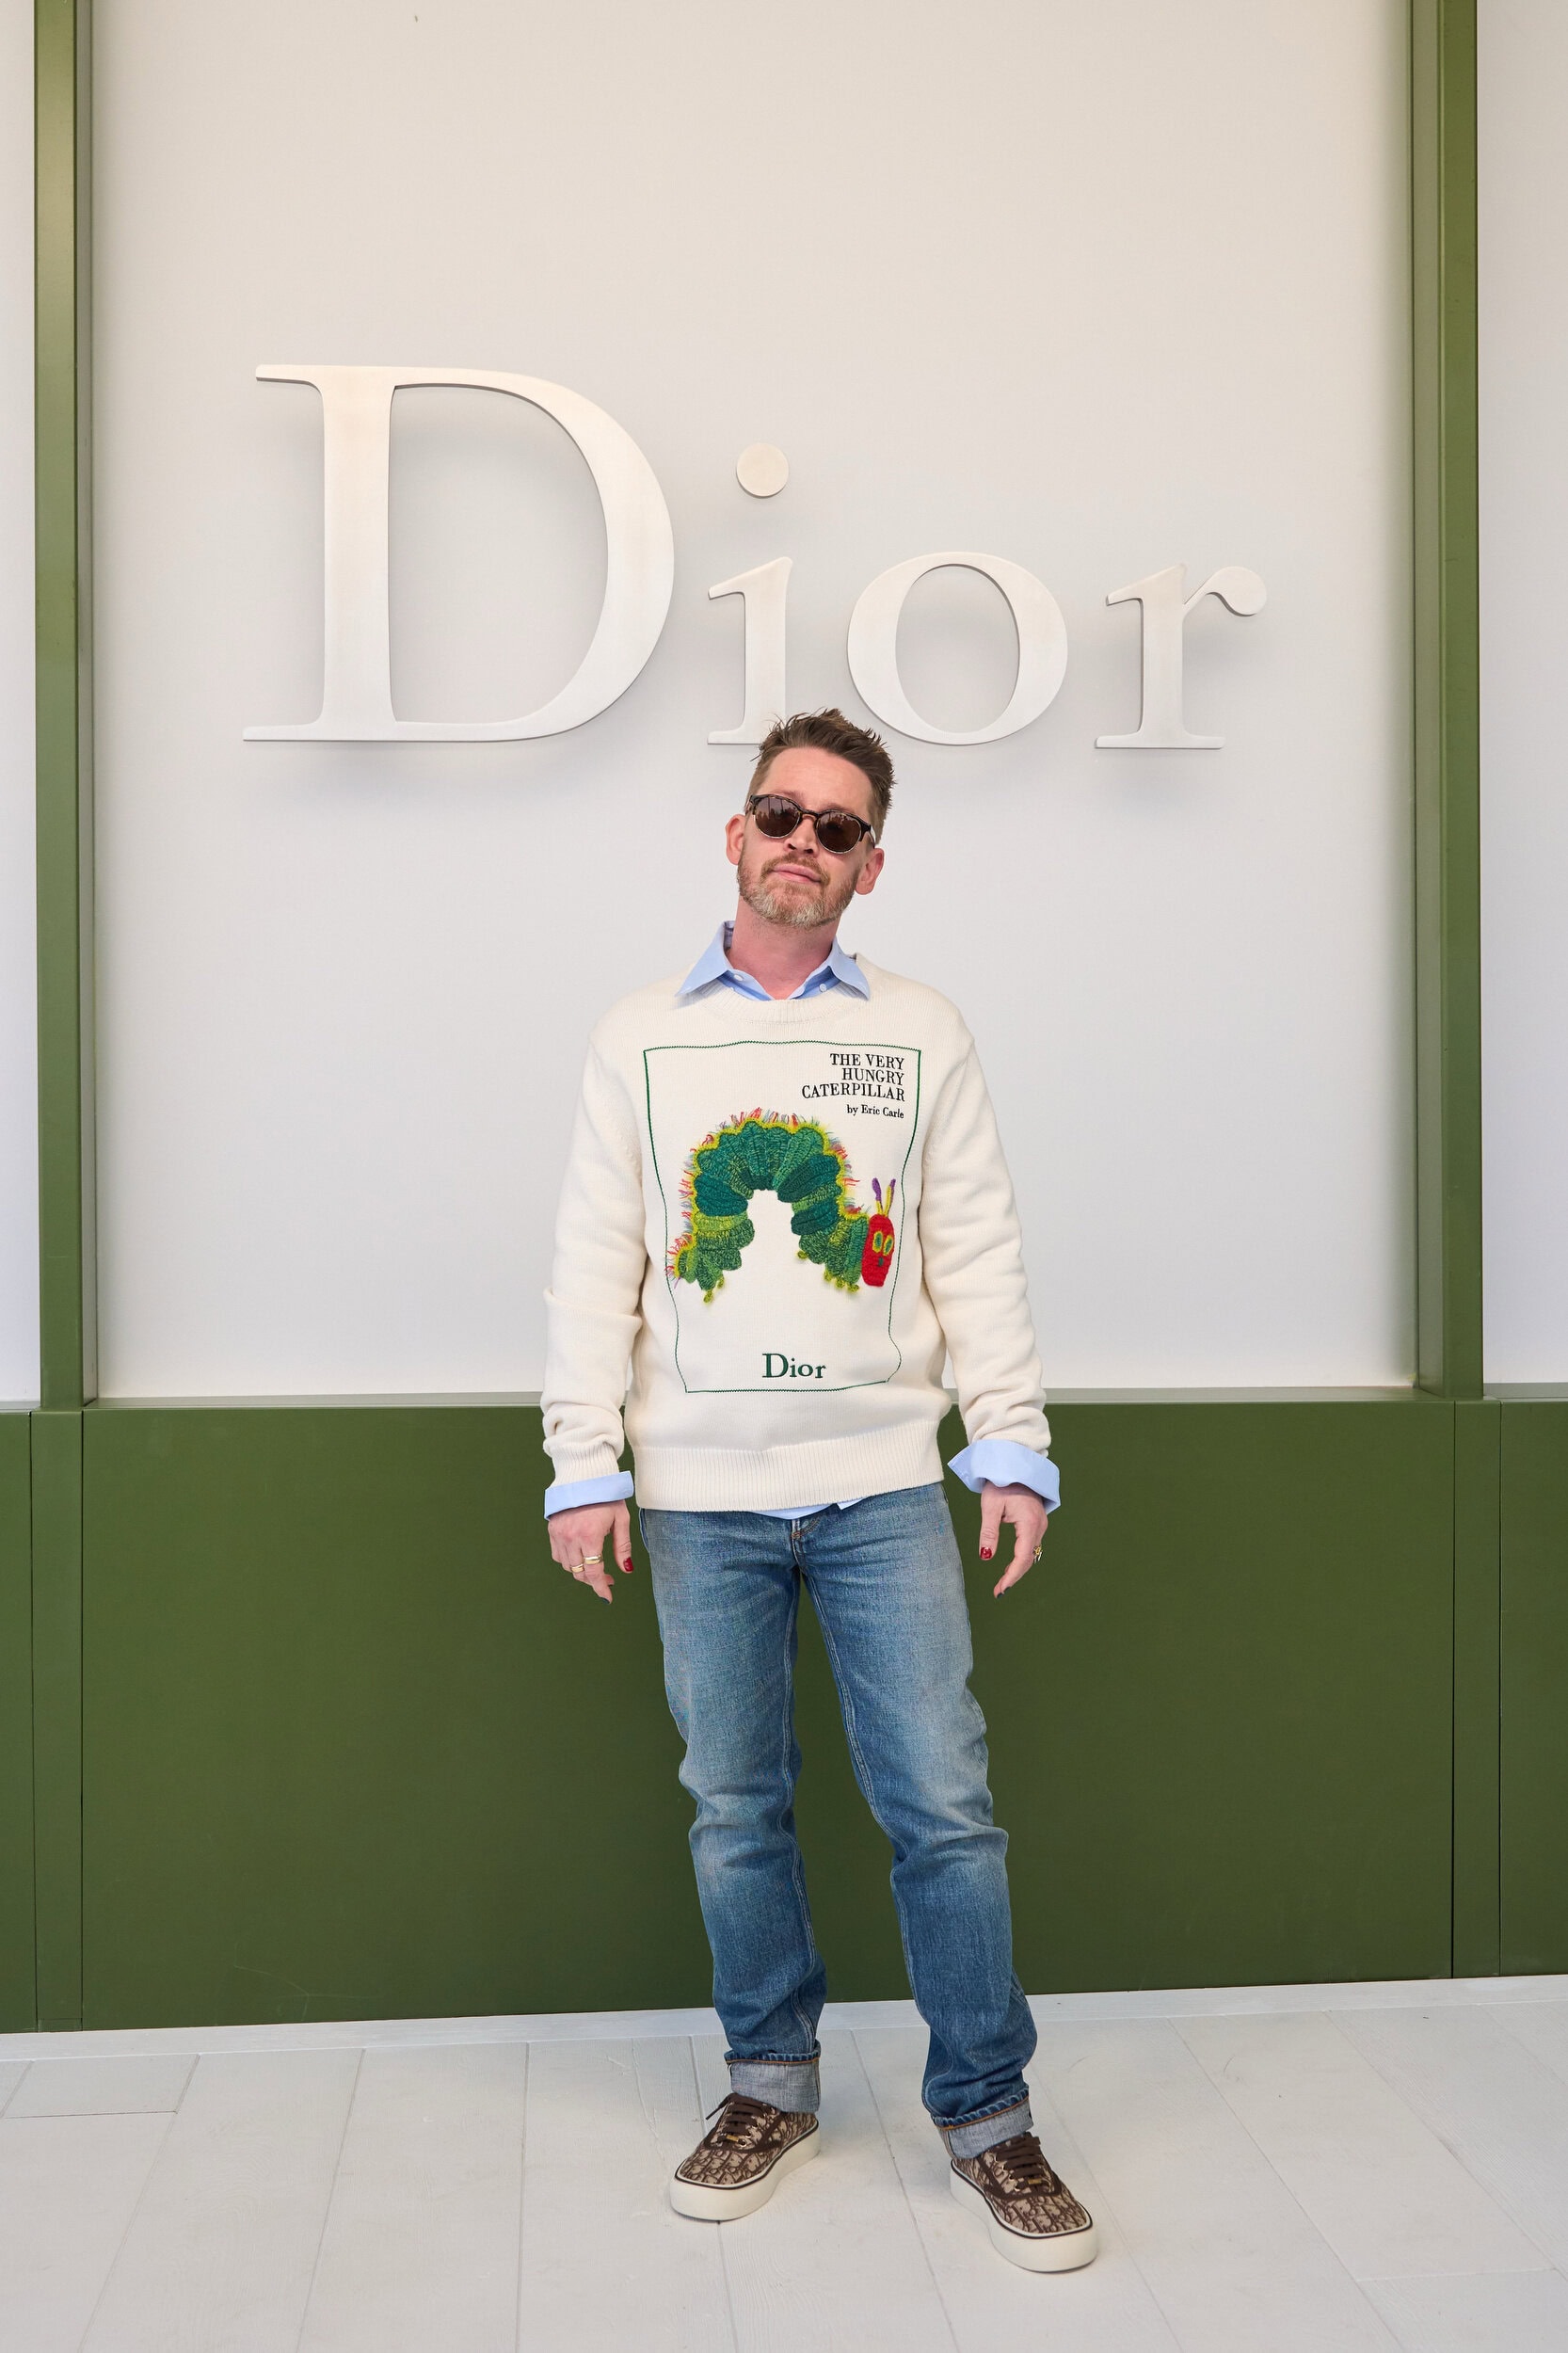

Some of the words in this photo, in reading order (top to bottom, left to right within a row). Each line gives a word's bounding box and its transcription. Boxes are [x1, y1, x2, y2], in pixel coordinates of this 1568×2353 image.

[242, 363, 1268, 749] Dior
[830, 1053, 861, 1066] THE
[865, 1053, 904, 1070] VERY
[841, 1067, 904, 1086] HUNGRY
[801, 1082, 905, 1102] CATERPILLAR
[847, 1104, 858, 1116] by
[861, 1104, 880, 1115] Eric
[882, 1107, 904, 1119] Carle
[761, 1353, 826, 1379] Dior
